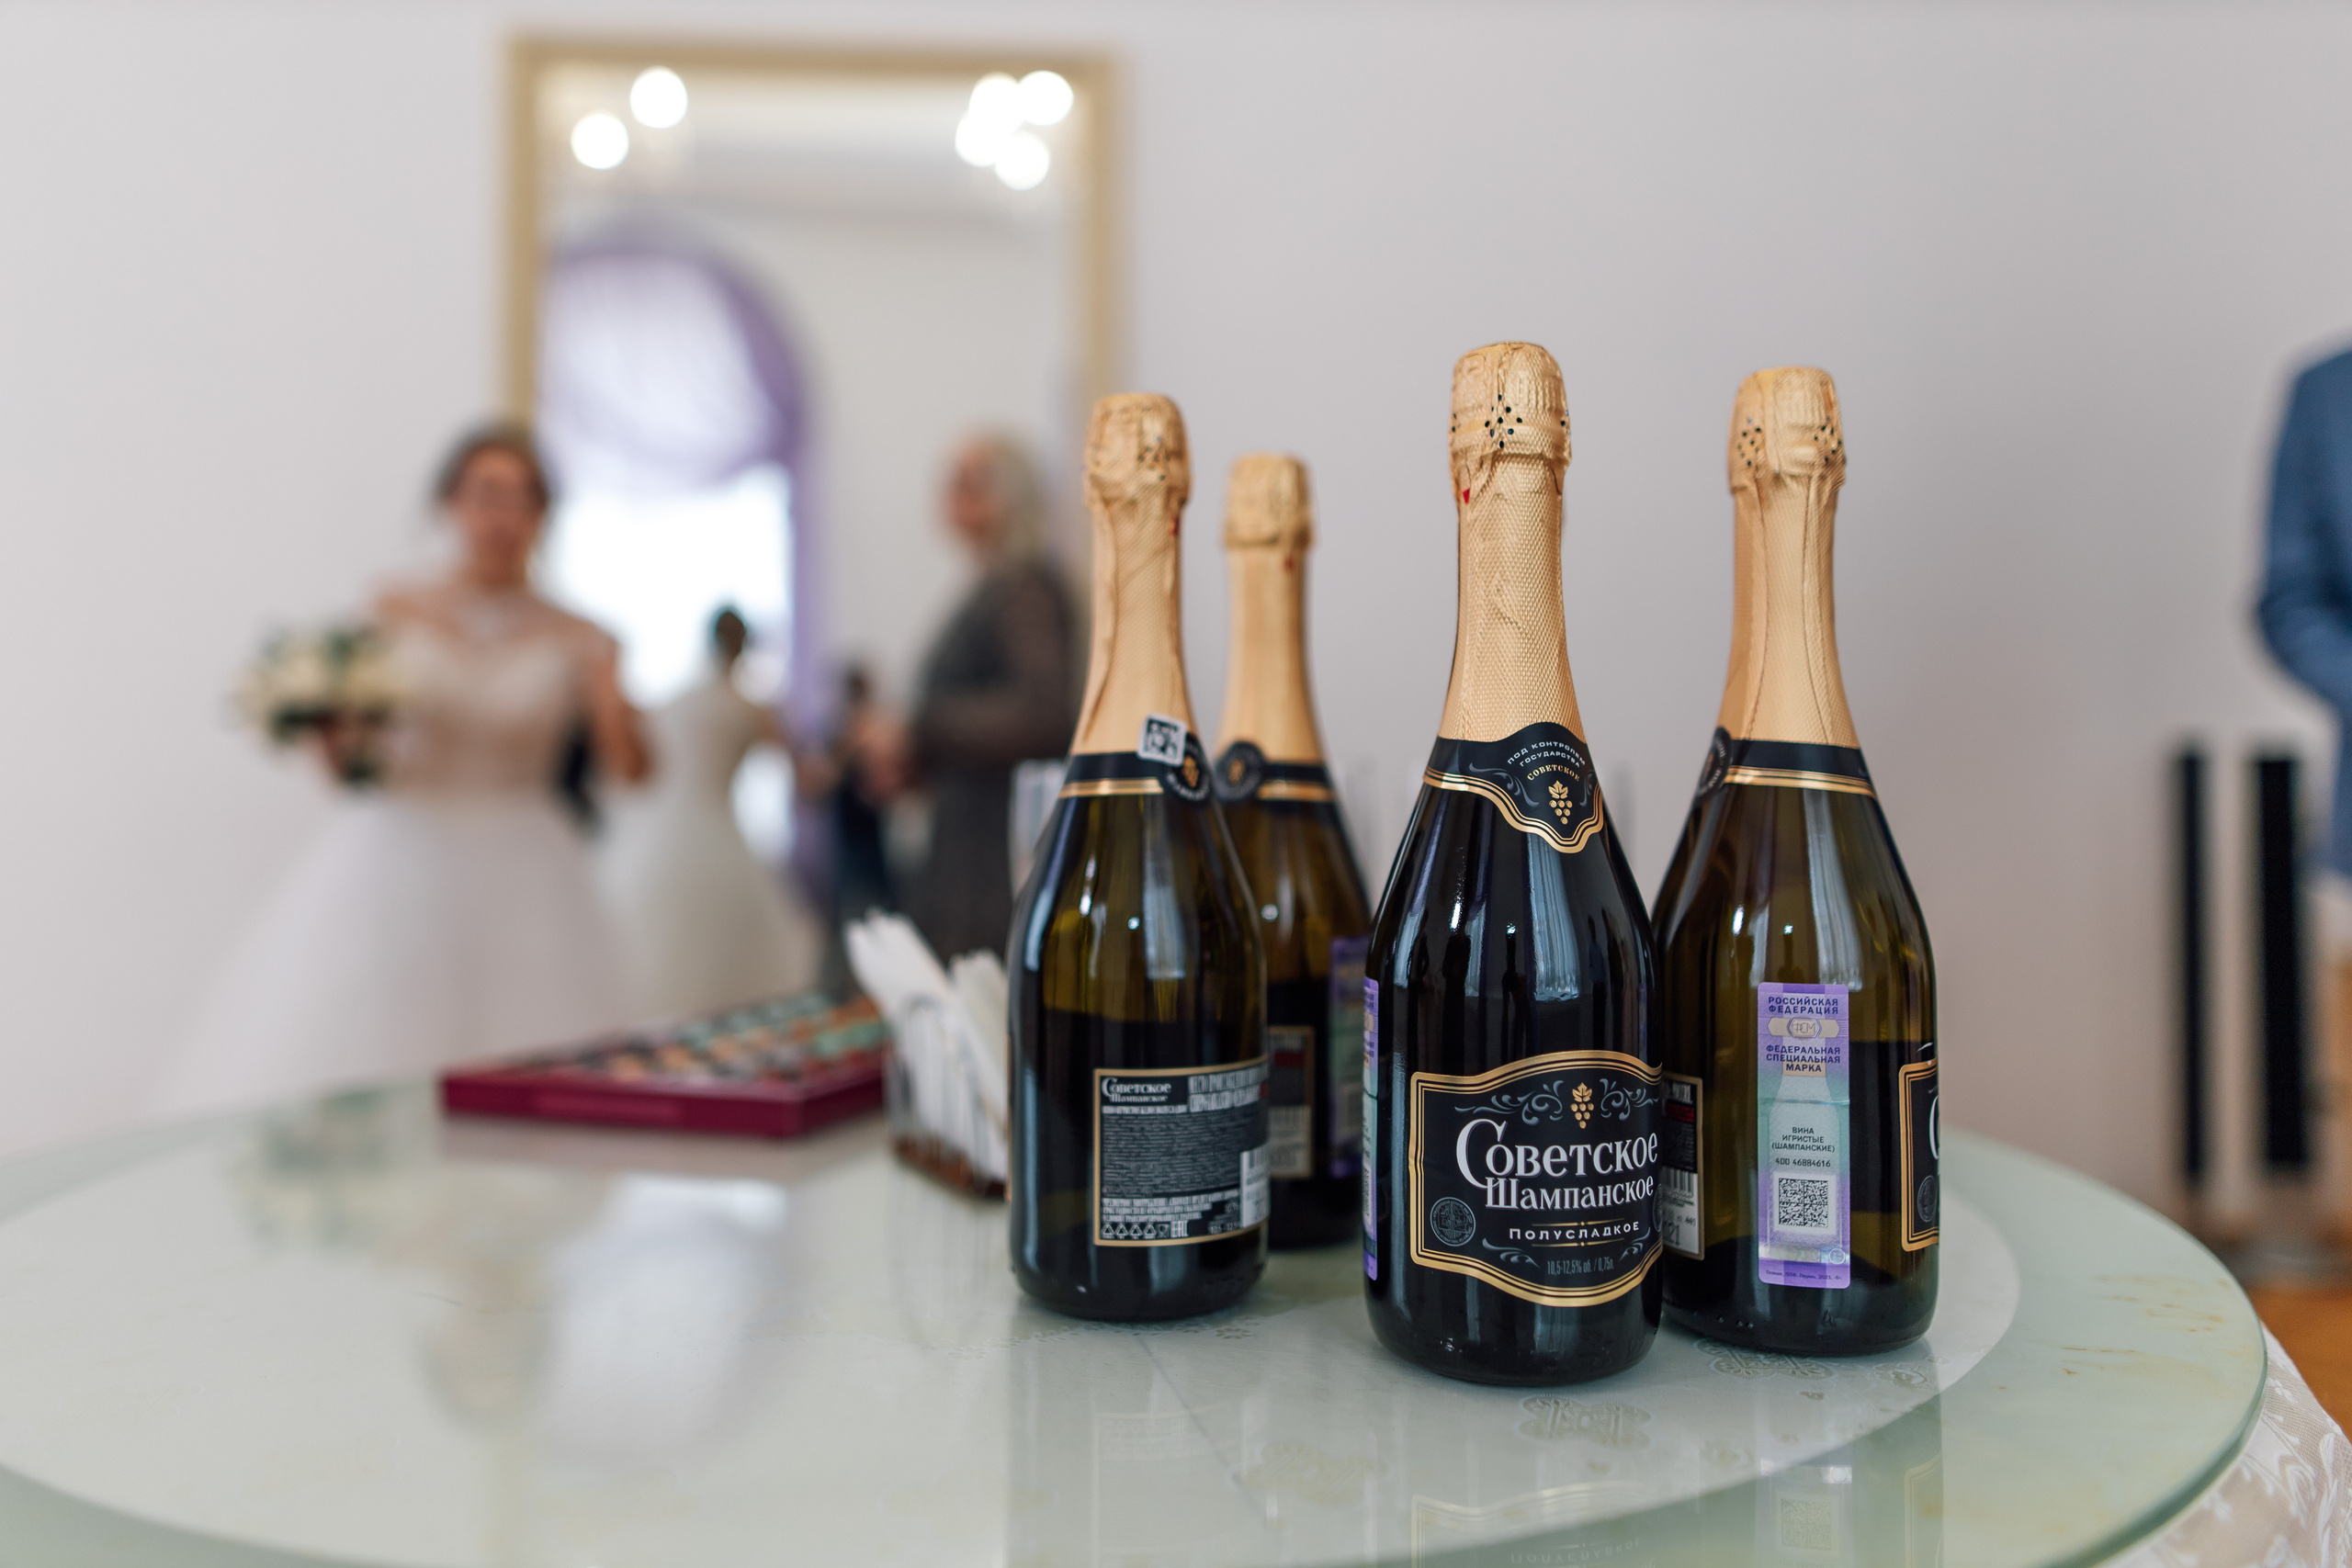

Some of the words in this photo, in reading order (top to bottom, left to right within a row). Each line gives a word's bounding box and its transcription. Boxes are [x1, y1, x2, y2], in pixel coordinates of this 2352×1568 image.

[1508, 748, 1529, 764] ПОД
[1532, 741, 1586, 765] КОНТРОЛЕМ
[1520, 750, 1580, 768] ГОСУДАРСТВА
[1527, 764, 1580, 782] СОВЕТСКОЕ
[1768, 997, 1838, 1006] РОССИЙСКАЯ
[1769, 1005, 1838, 1015] ФЕДЕРАЦИЯ
[1766, 1044, 1840, 1055] ФЕДЕРАЛЬНАЯ
[1766, 1054, 1840, 1064] СПЕЦИАЛЬНАЯ
[1786, 1064, 1822, 1072] МАРКА
[1102, 1077, 1171, 1098] Советское
[1782, 1134, 1825, 1143] ИГРИСТЫЕ
[1771, 1142, 1836, 1153] (ШАМПАНСКИЕ)
[1456, 1118, 1658, 1189] Советское
[1775, 1157, 1790, 1166] 400
[1792, 1159, 1831, 1168] 46884616
[1485, 1176, 1654, 1210] Шампанское
